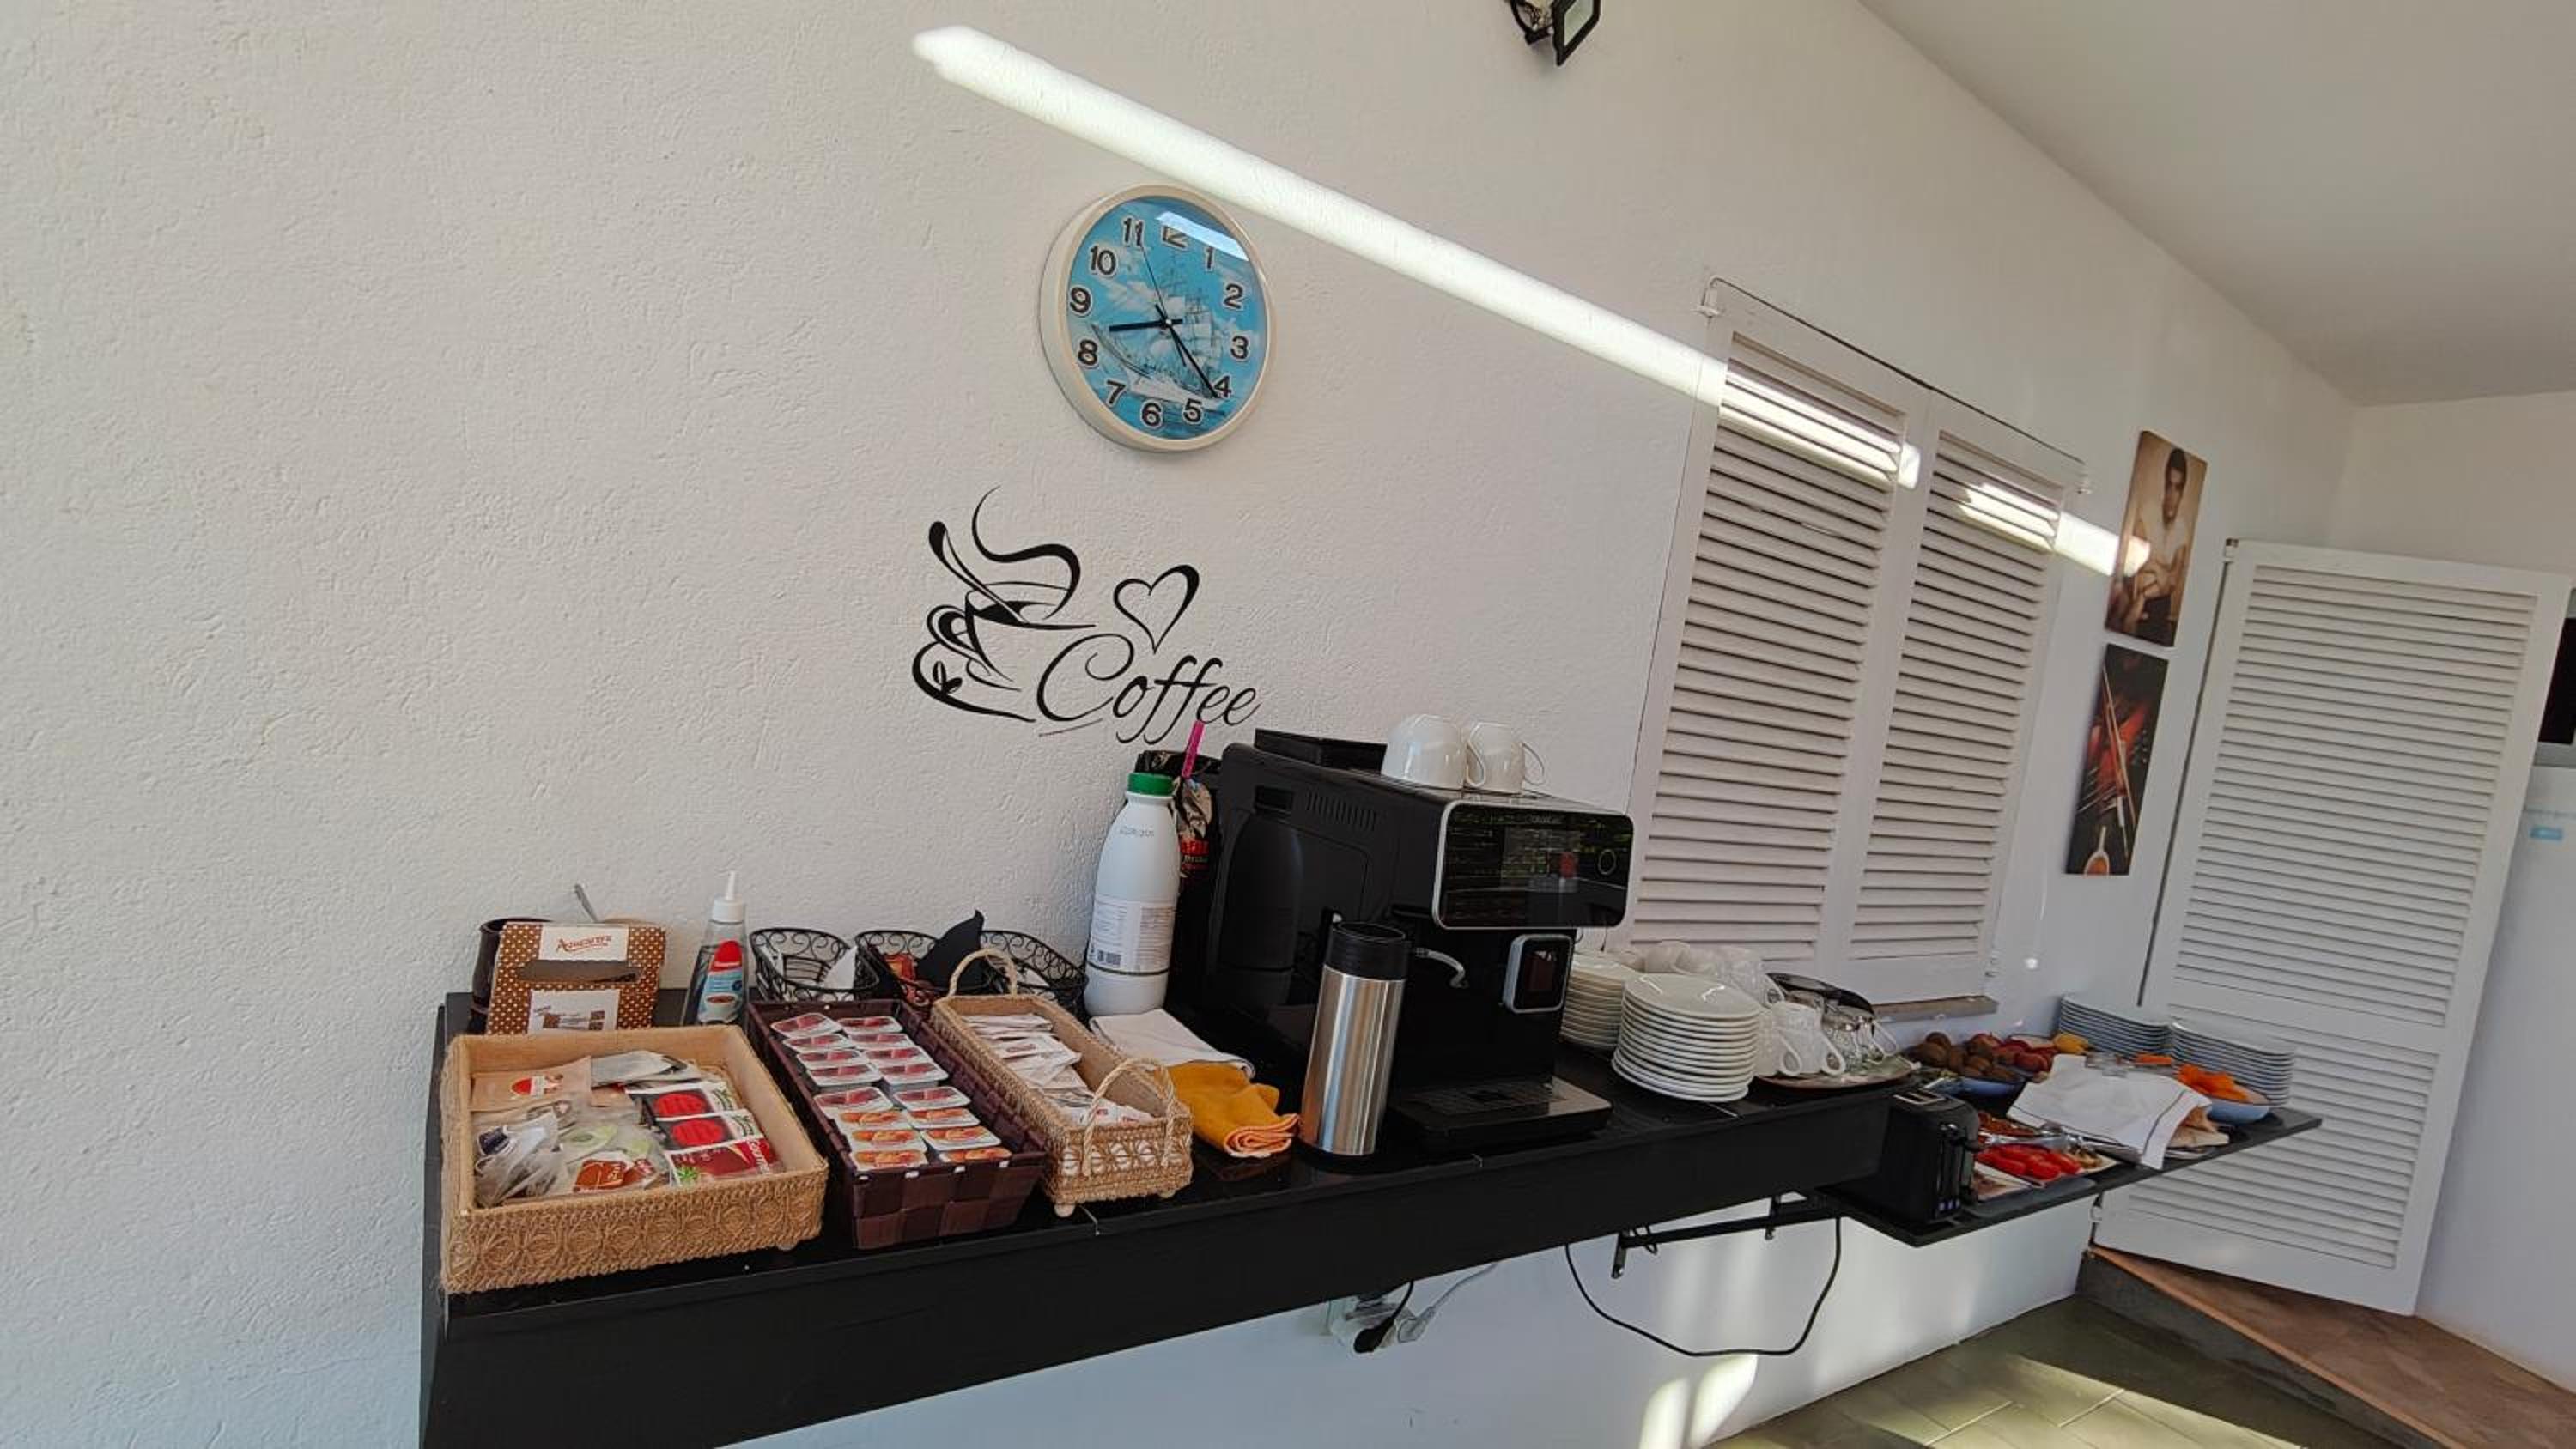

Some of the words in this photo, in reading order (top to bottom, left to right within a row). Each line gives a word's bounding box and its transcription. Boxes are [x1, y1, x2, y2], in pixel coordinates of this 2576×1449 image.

[1122, 218, 1144, 246] 11
[1090, 245, 1117, 276] 10
[1205, 246, 1214, 270] 1
[1069, 287, 1091, 314] 9
[1223, 283, 1244, 310] 2
[1078, 340, 1099, 367] 8
[1230, 335, 1249, 360] 3
[1106, 379, 1126, 405] 7
[1214, 375, 1232, 398] 4
[1140, 403, 1162, 427] 6
[1182, 398, 1202, 423] 5
[1036, 633, 1261, 746] Coffee
